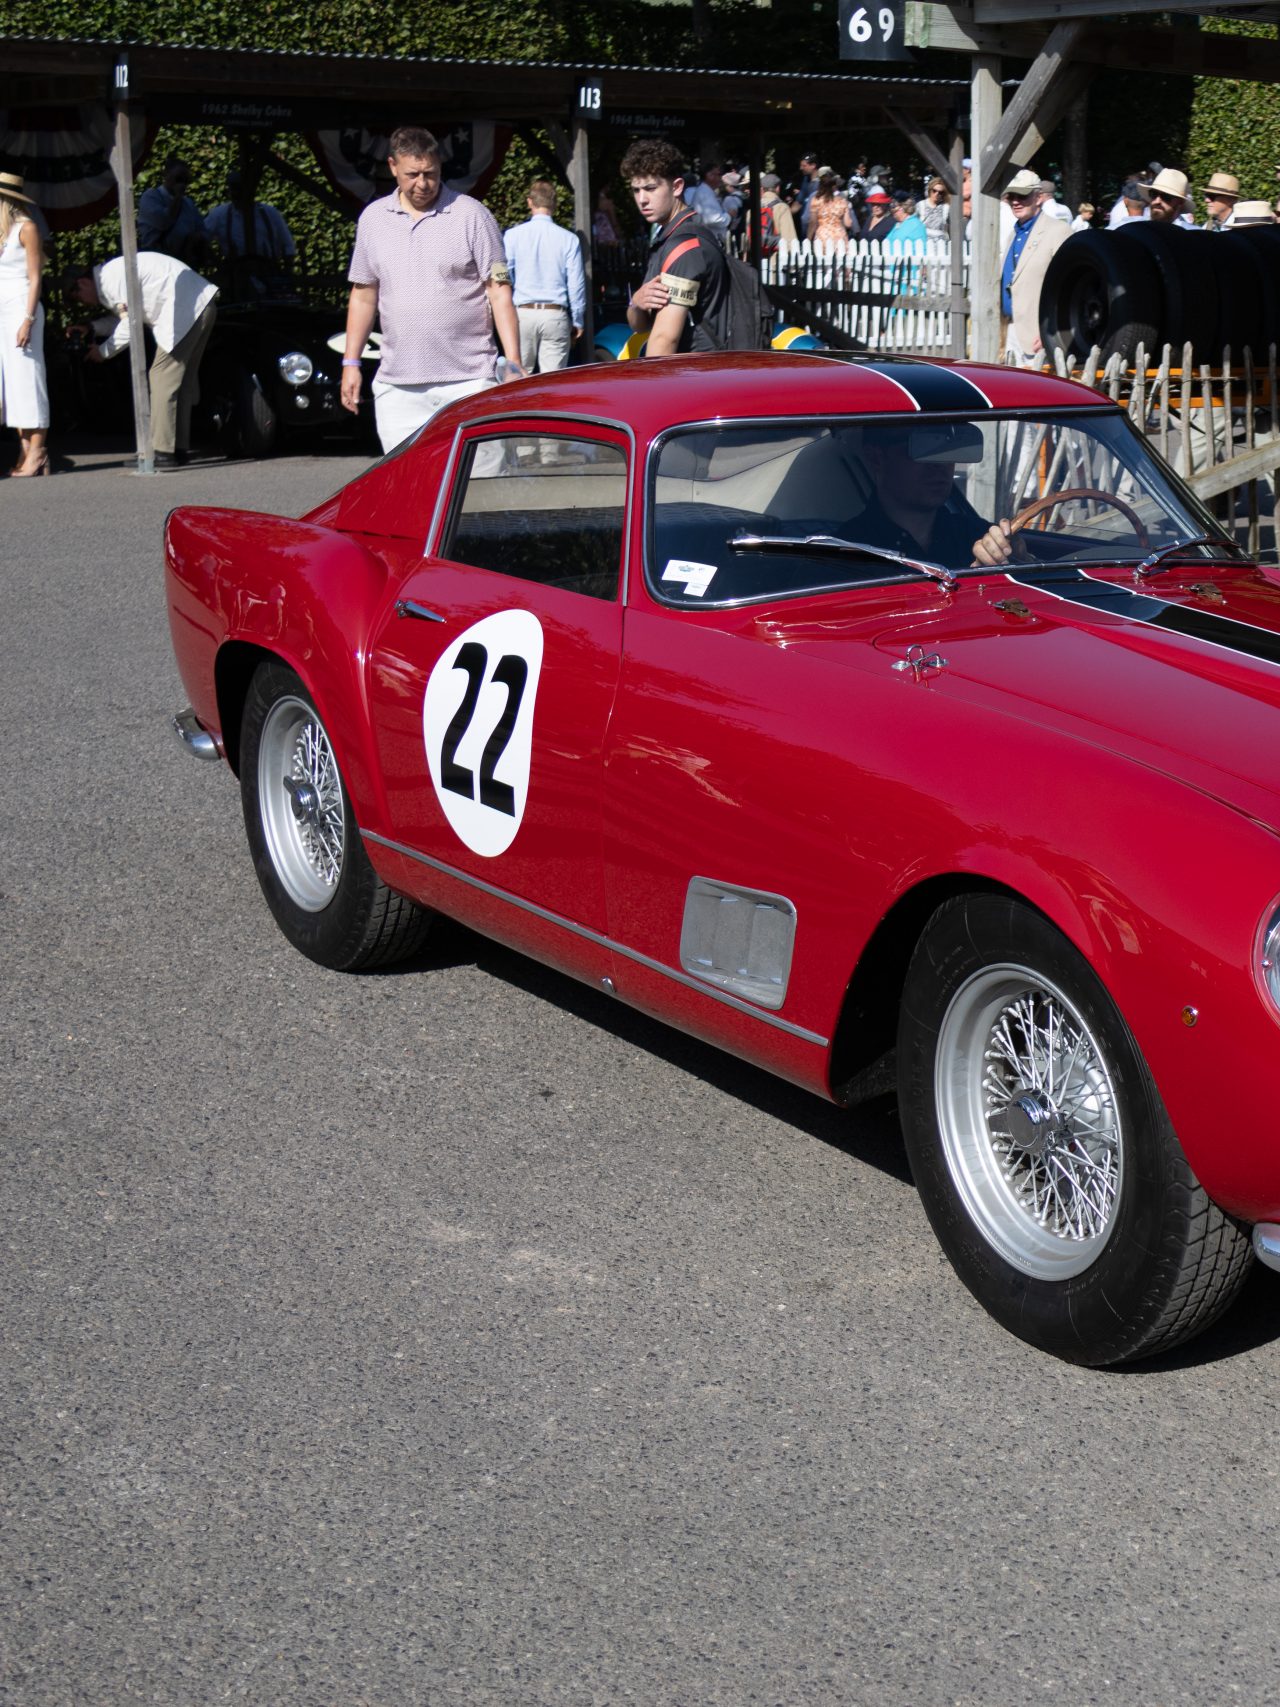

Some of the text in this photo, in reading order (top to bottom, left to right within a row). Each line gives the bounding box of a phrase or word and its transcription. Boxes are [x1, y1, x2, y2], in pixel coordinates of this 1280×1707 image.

[848, 7, 895, 43] 69
[116, 64, 129, 88] 112
[580, 86, 601, 110] 113
[441, 641, 528, 818] 22
